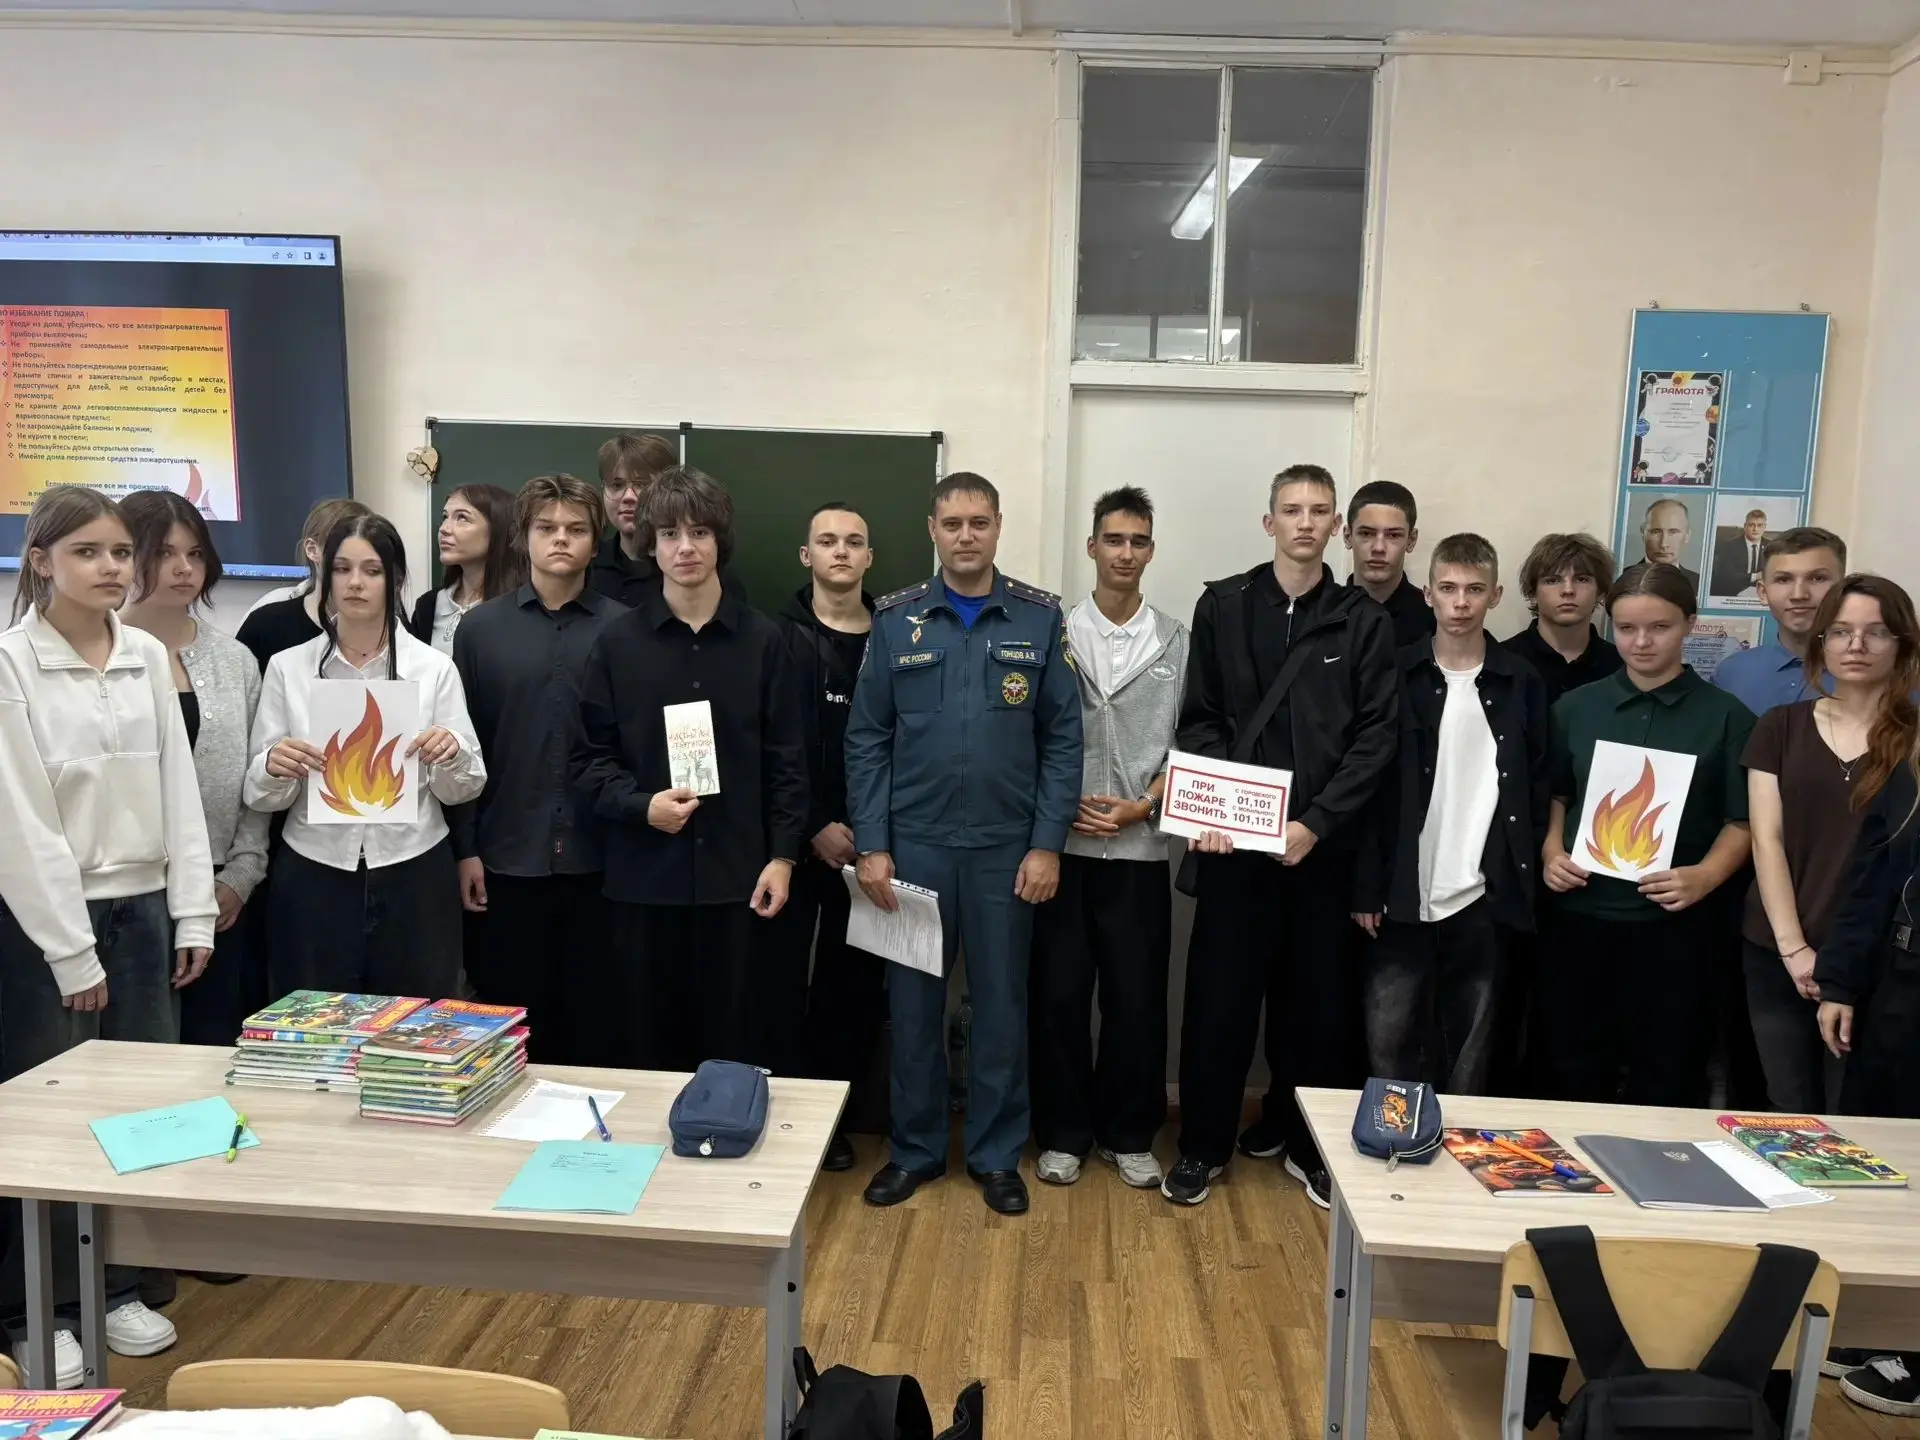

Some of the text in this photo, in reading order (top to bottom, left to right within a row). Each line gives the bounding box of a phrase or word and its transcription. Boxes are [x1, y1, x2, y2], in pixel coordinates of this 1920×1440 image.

[53, 310, 85, 318] ПОЖАРА
[136, 323, 223, 331] электронагревательные
[29, 342, 72, 350] применяйте
[138, 344, 224, 352] электронагревательные
[23, 361, 65, 370] пользуйтесь
[13, 372, 41, 380] Храните
[149, 375, 182, 383] приборы
[213, 386, 227, 394] без
[1655, 387, 1705, 395] ГРАМОТА
[14, 392, 54, 400] присмотра;
[86, 405, 177, 413] легковоспламеняющиеся
[26, 423, 82, 432] загромождайте
[83, 423, 114, 431] балконы
[28, 443, 71, 451] пользуйтесь
[92, 445, 130, 453] открытым
[18, 452, 45, 460] Имейте
[139, 457, 200, 465] пожаротушения.
[911, 652, 933, 663] РОССИИ
[1191, 779, 1215, 793] ПРИ
[1177, 788, 1226, 807] ПОЖАРЕ
[1237, 796, 1272, 809] 01,101
[1173, 800, 1228, 820] ЗВОНИТЬ
[1232, 813, 1273, 828] 101,112
